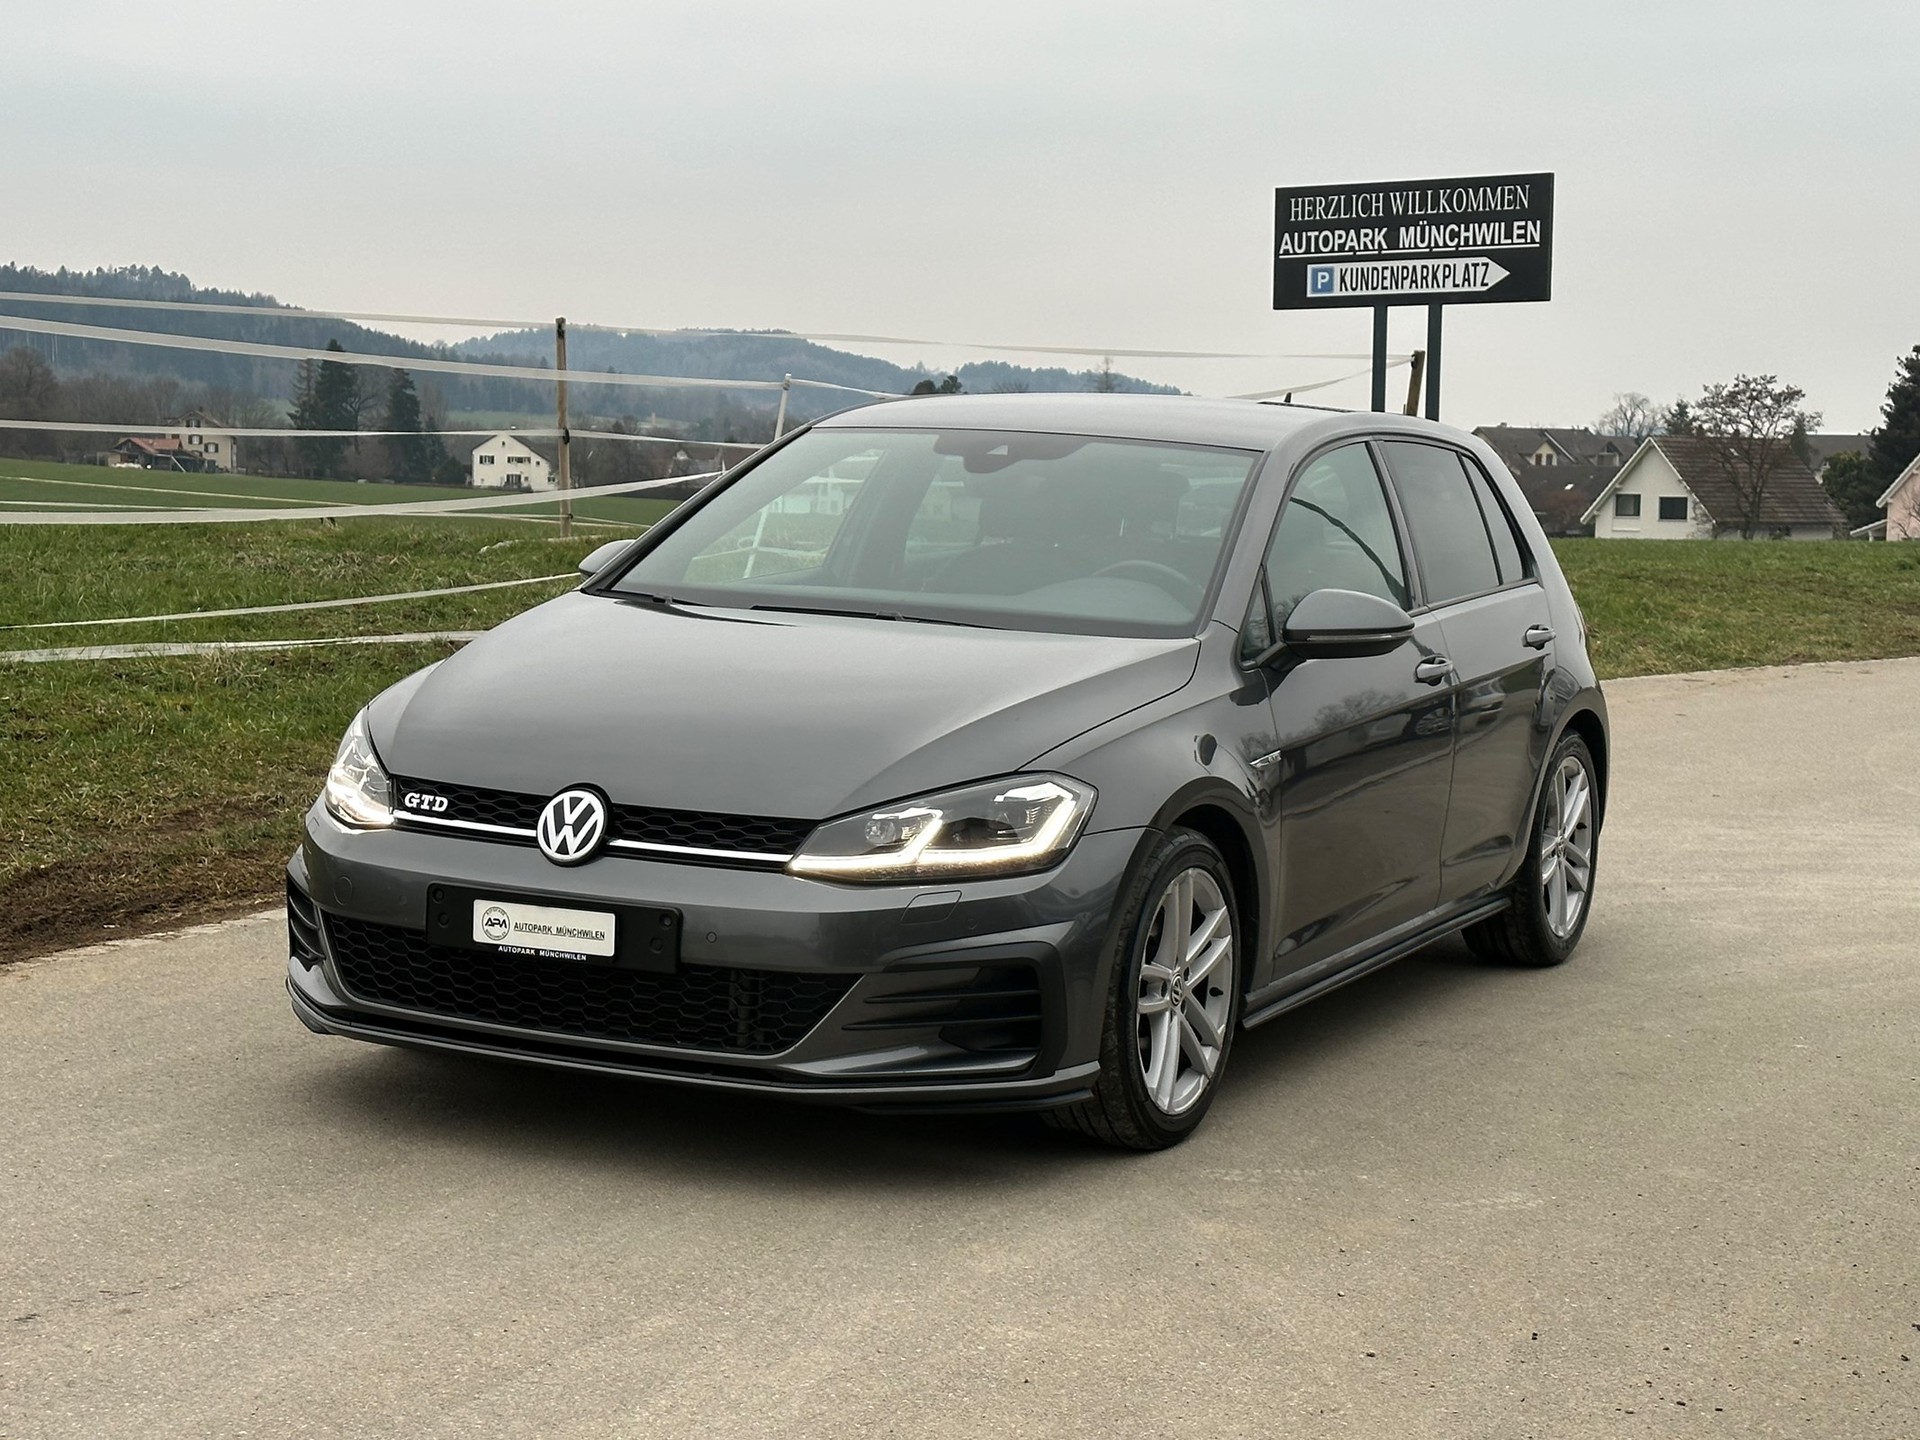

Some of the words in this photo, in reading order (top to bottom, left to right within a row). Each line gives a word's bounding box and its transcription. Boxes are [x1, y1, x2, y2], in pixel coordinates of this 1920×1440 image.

[1290, 192, 1384, 221] HERZLICH
[1390, 185, 1530, 215] WILLKOMMEN
[1279, 228, 1388, 254] AUTOPARK
[1400, 220, 1541, 249] MÜNCHWILEN
[1317, 271, 1329, 289] P
[1339, 262, 1490, 292] KUNDENPARKPLATZ
[404, 792, 448, 812] GTD
[513, 922, 552, 934] AUTOPARK
[556, 926, 605, 940] MÜNCHWILEN
[498, 945, 535, 956] AUTOPARK
[539, 949, 587, 961] MÜNCHWILEN
